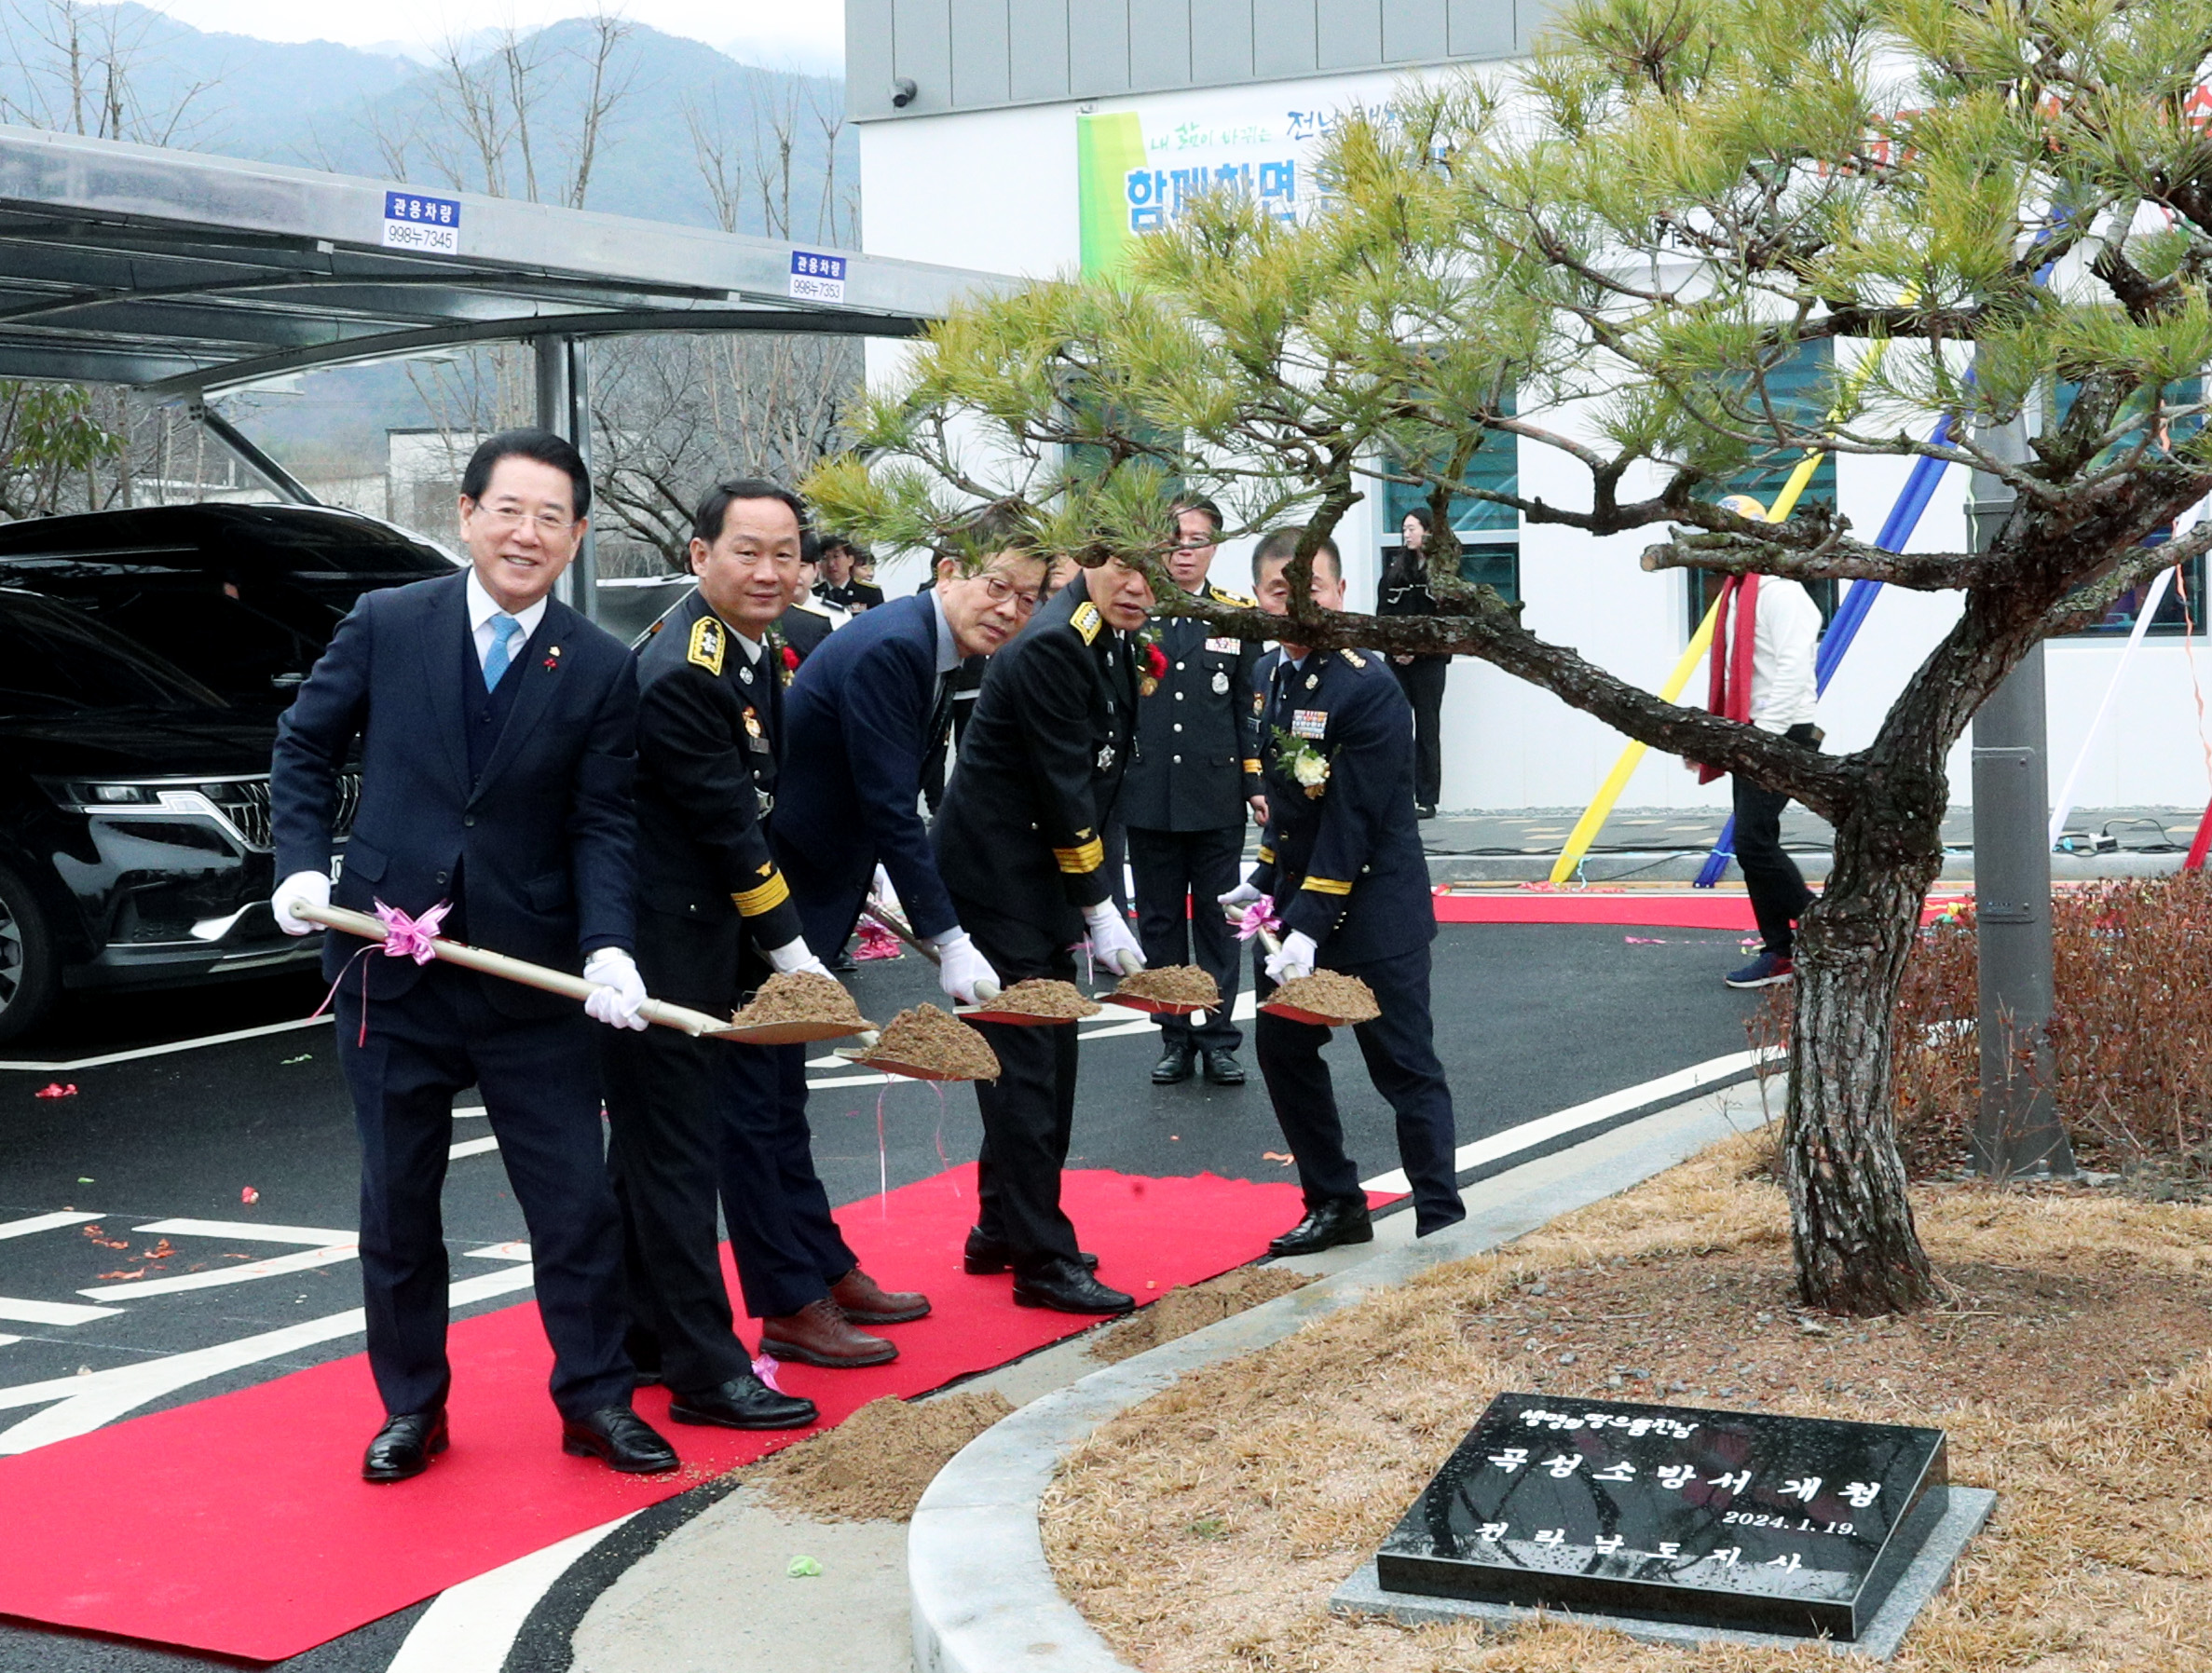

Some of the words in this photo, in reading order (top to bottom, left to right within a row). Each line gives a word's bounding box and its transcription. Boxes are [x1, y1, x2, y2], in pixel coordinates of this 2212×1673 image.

[1150, 134, 1169, 150] 내
[1222, 125, 1273, 146] 바뀌는
[393, 197, 452, 224] 관용차량
[389, 224, 453, 249] 998누7345
[798, 255, 840, 278] 관용차량
